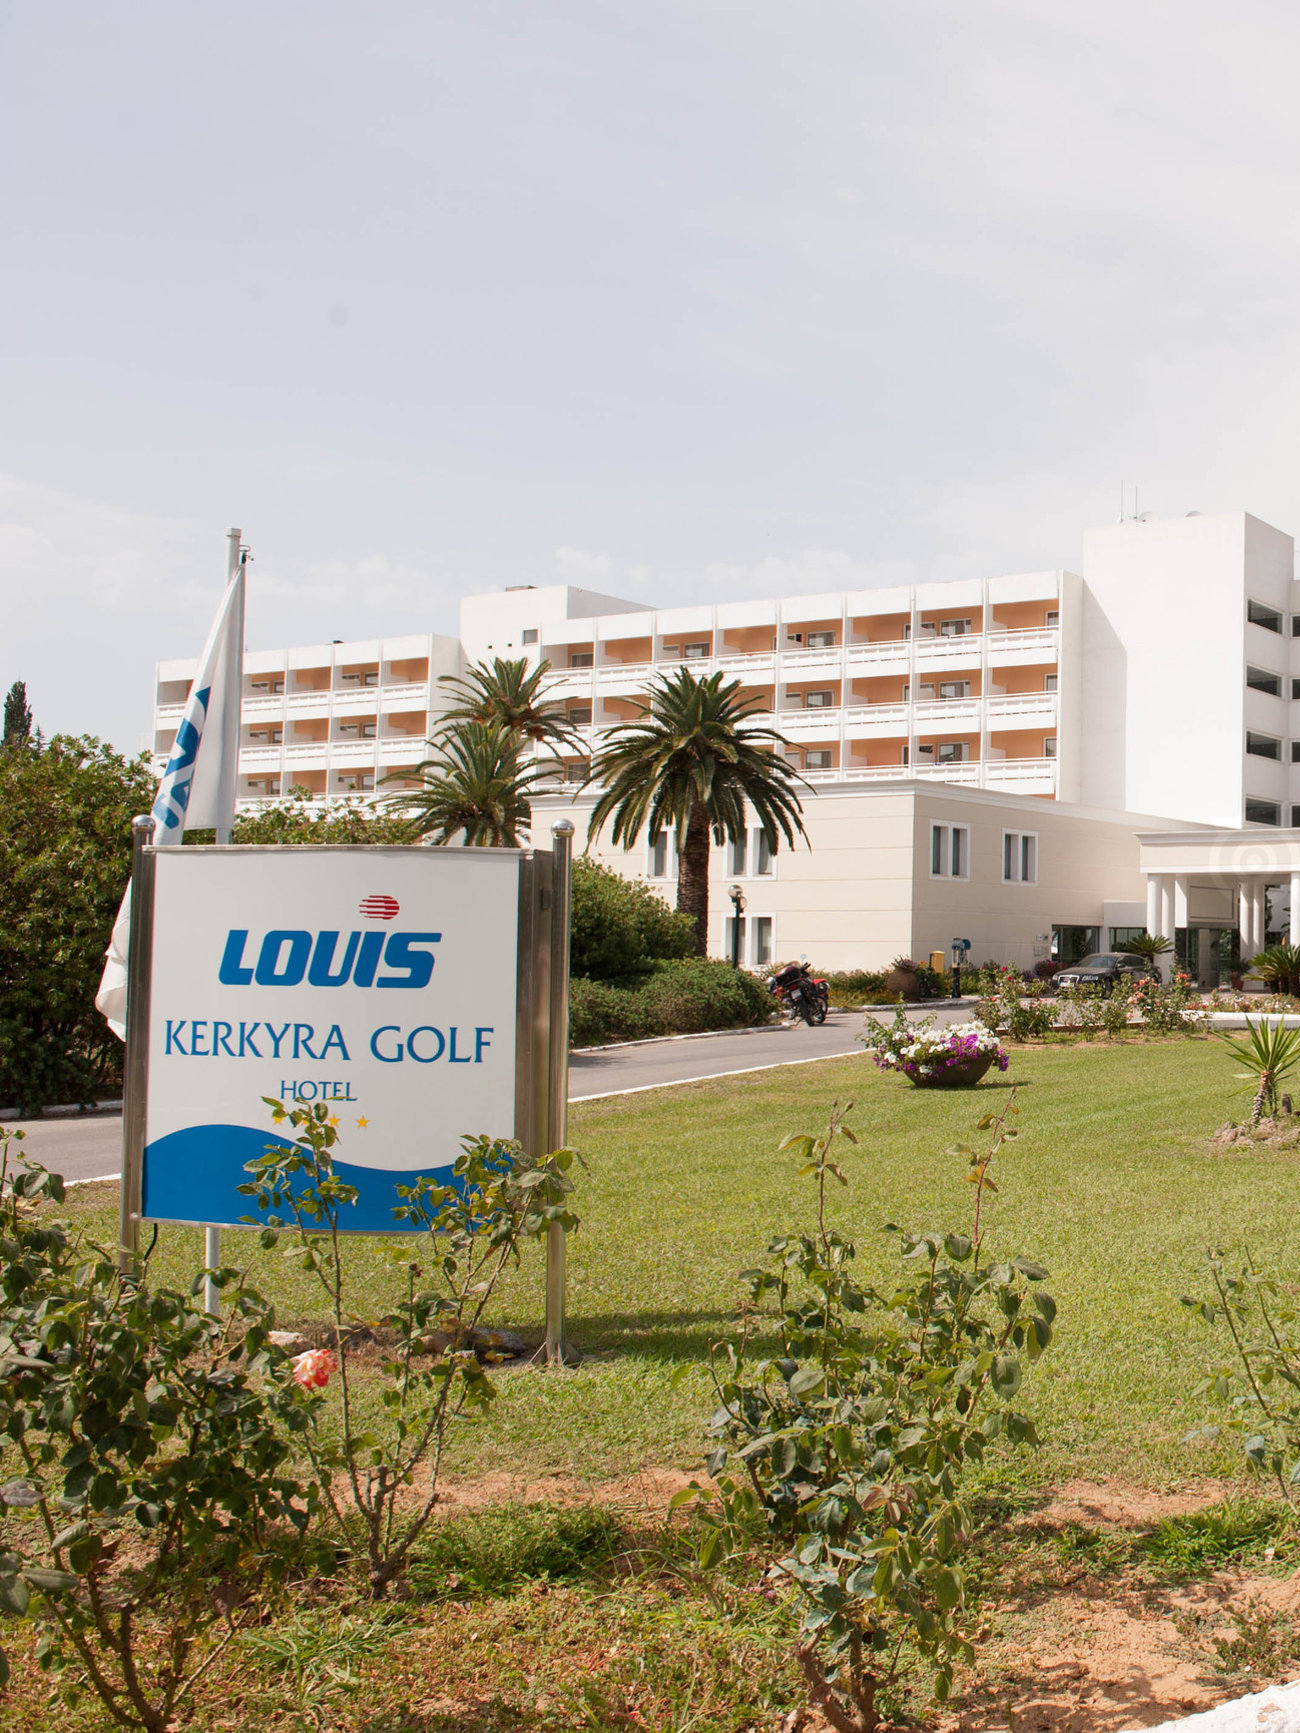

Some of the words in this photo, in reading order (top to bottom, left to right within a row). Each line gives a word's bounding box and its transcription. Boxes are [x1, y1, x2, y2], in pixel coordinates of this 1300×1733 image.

[218, 929, 442, 989] LOUIS
[164, 1019, 351, 1061] KERKYRA
[369, 1025, 495, 1064] GOLF
[280, 1080, 358, 1102] HOTEL
